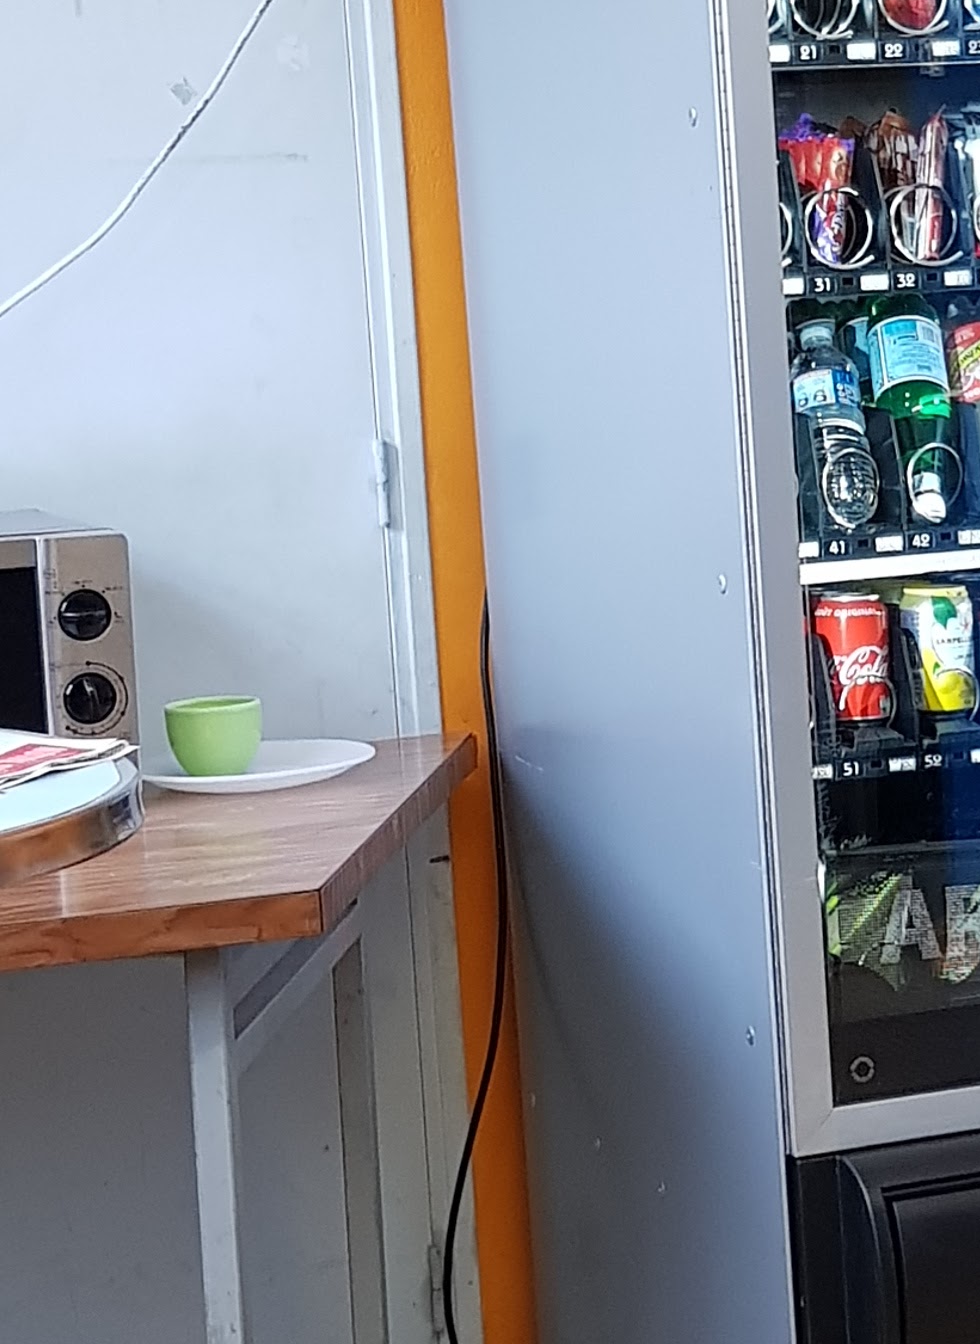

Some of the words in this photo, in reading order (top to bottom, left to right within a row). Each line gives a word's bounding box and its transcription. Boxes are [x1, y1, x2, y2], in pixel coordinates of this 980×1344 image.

[799, 44, 817, 60] 21
[884, 43, 904, 58] 22
[813, 277, 831, 292] 31
[896, 273, 916, 288] 32
[828, 539, 846, 555] 41
[911, 532, 930, 549] 42
[842, 761, 860, 776] 51
[923, 754, 943, 769] 52
